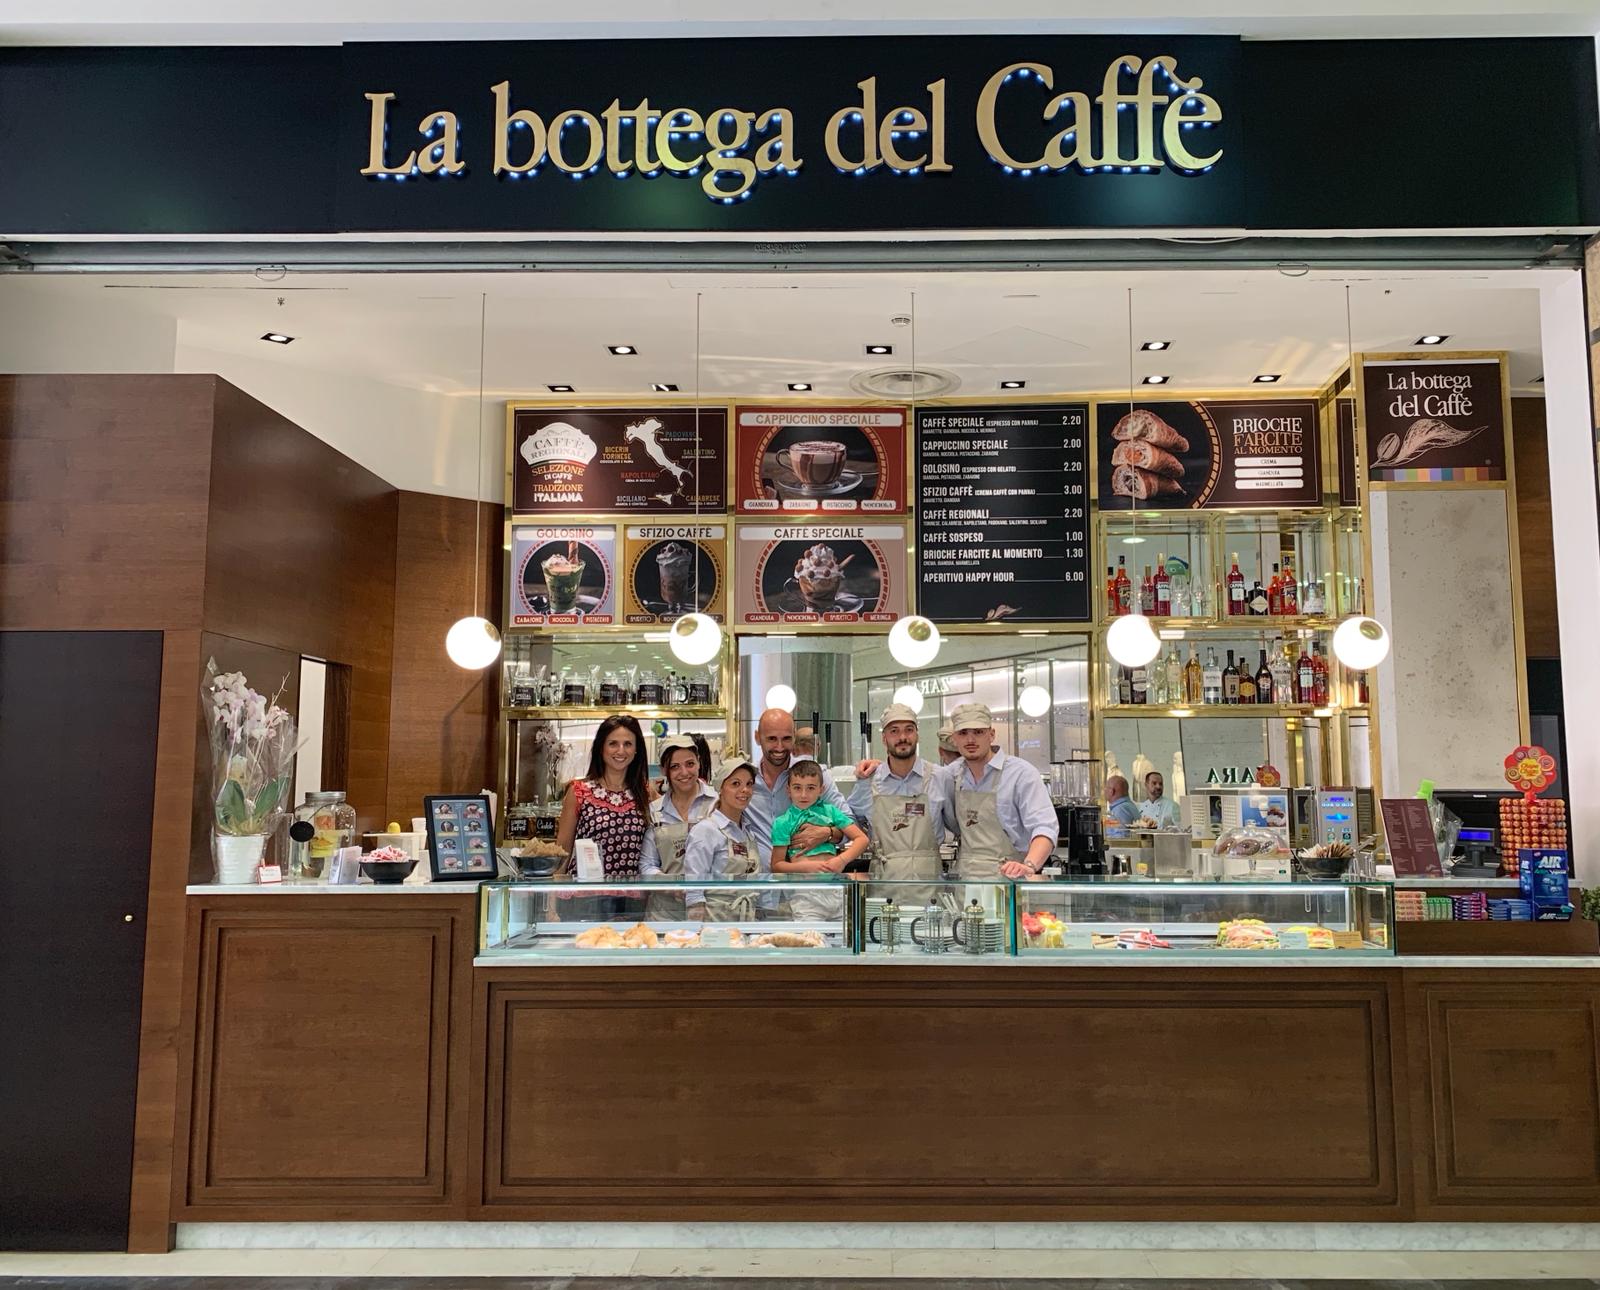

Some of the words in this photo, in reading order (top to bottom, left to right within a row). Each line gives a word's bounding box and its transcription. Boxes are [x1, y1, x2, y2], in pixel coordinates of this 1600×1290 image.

[360, 92, 466, 175] La
[490, 80, 802, 199] bottega
[824, 76, 953, 173] del
[976, 55, 1223, 170] Caffè
[1387, 373, 1408, 390] La
[1411, 371, 1472, 393] bottega
[1389, 395, 1420, 417] del
[1424, 393, 1473, 417] Caffè
[756, 414, 827, 425] CAPPUCCINO
[829, 414, 881, 425] SPECIALE
[922, 416, 947, 428] CAFFÈ
[948, 417, 985, 428] SPECIALE
[1062, 415, 1081, 425] 2.20
[1233, 417, 1303, 434] BRIOCHE
[922, 440, 971, 450] CAPPUCCINO
[972, 439, 1009, 450] SPECIALE
[1063, 438, 1082, 449] 2.00
[1234, 431, 1303, 446] FARCITE
[1234, 447, 1247, 455] AL
[1249, 445, 1303, 455] MOMENTO
[532, 464, 585, 476] SELEZIONE
[922, 463, 960, 474] GOLOSINO
[1063, 461, 1082, 471] 2.20
[533, 484, 584, 492] TRADIZIONE
[923, 486, 948, 497] SFIZIO
[949, 484, 973, 496] CAFFÈ
[1063, 485, 1082, 495] 3.00
[534, 492, 584, 503] ITALIANA
[923, 508, 948, 520] CAFFÈ
[948, 508, 989, 519] REGIONALI
[1064, 508, 1083, 518] 2.20
[537, 528, 594, 539] GOLOSINO
[640, 527, 675, 538] SFIZIO
[812, 527, 864, 538] SPECIALE
[923, 530, 948, 543] CAFFÈ
[949, 532, 984, 543] SOSPESO
[1065, 531, 1083, 541] 1.00
[923, 549, 957, 560] BRIOCHE
[958, 549, 990, 559] FARCITE
[992, 549, 1002, 559] AL
[1003, 548, 1043, 559] MOMENTO
[1066, 548, 1083, 558] 1.30
[923, 573, 964, 582] APERITIVO
[965, 572, 991, 582] HAPPY
[993, 572, 1015, 581] HOUR
[1065, 571, 1084, 581] 6.00
[1538, 856, 1562, 869] AIR
